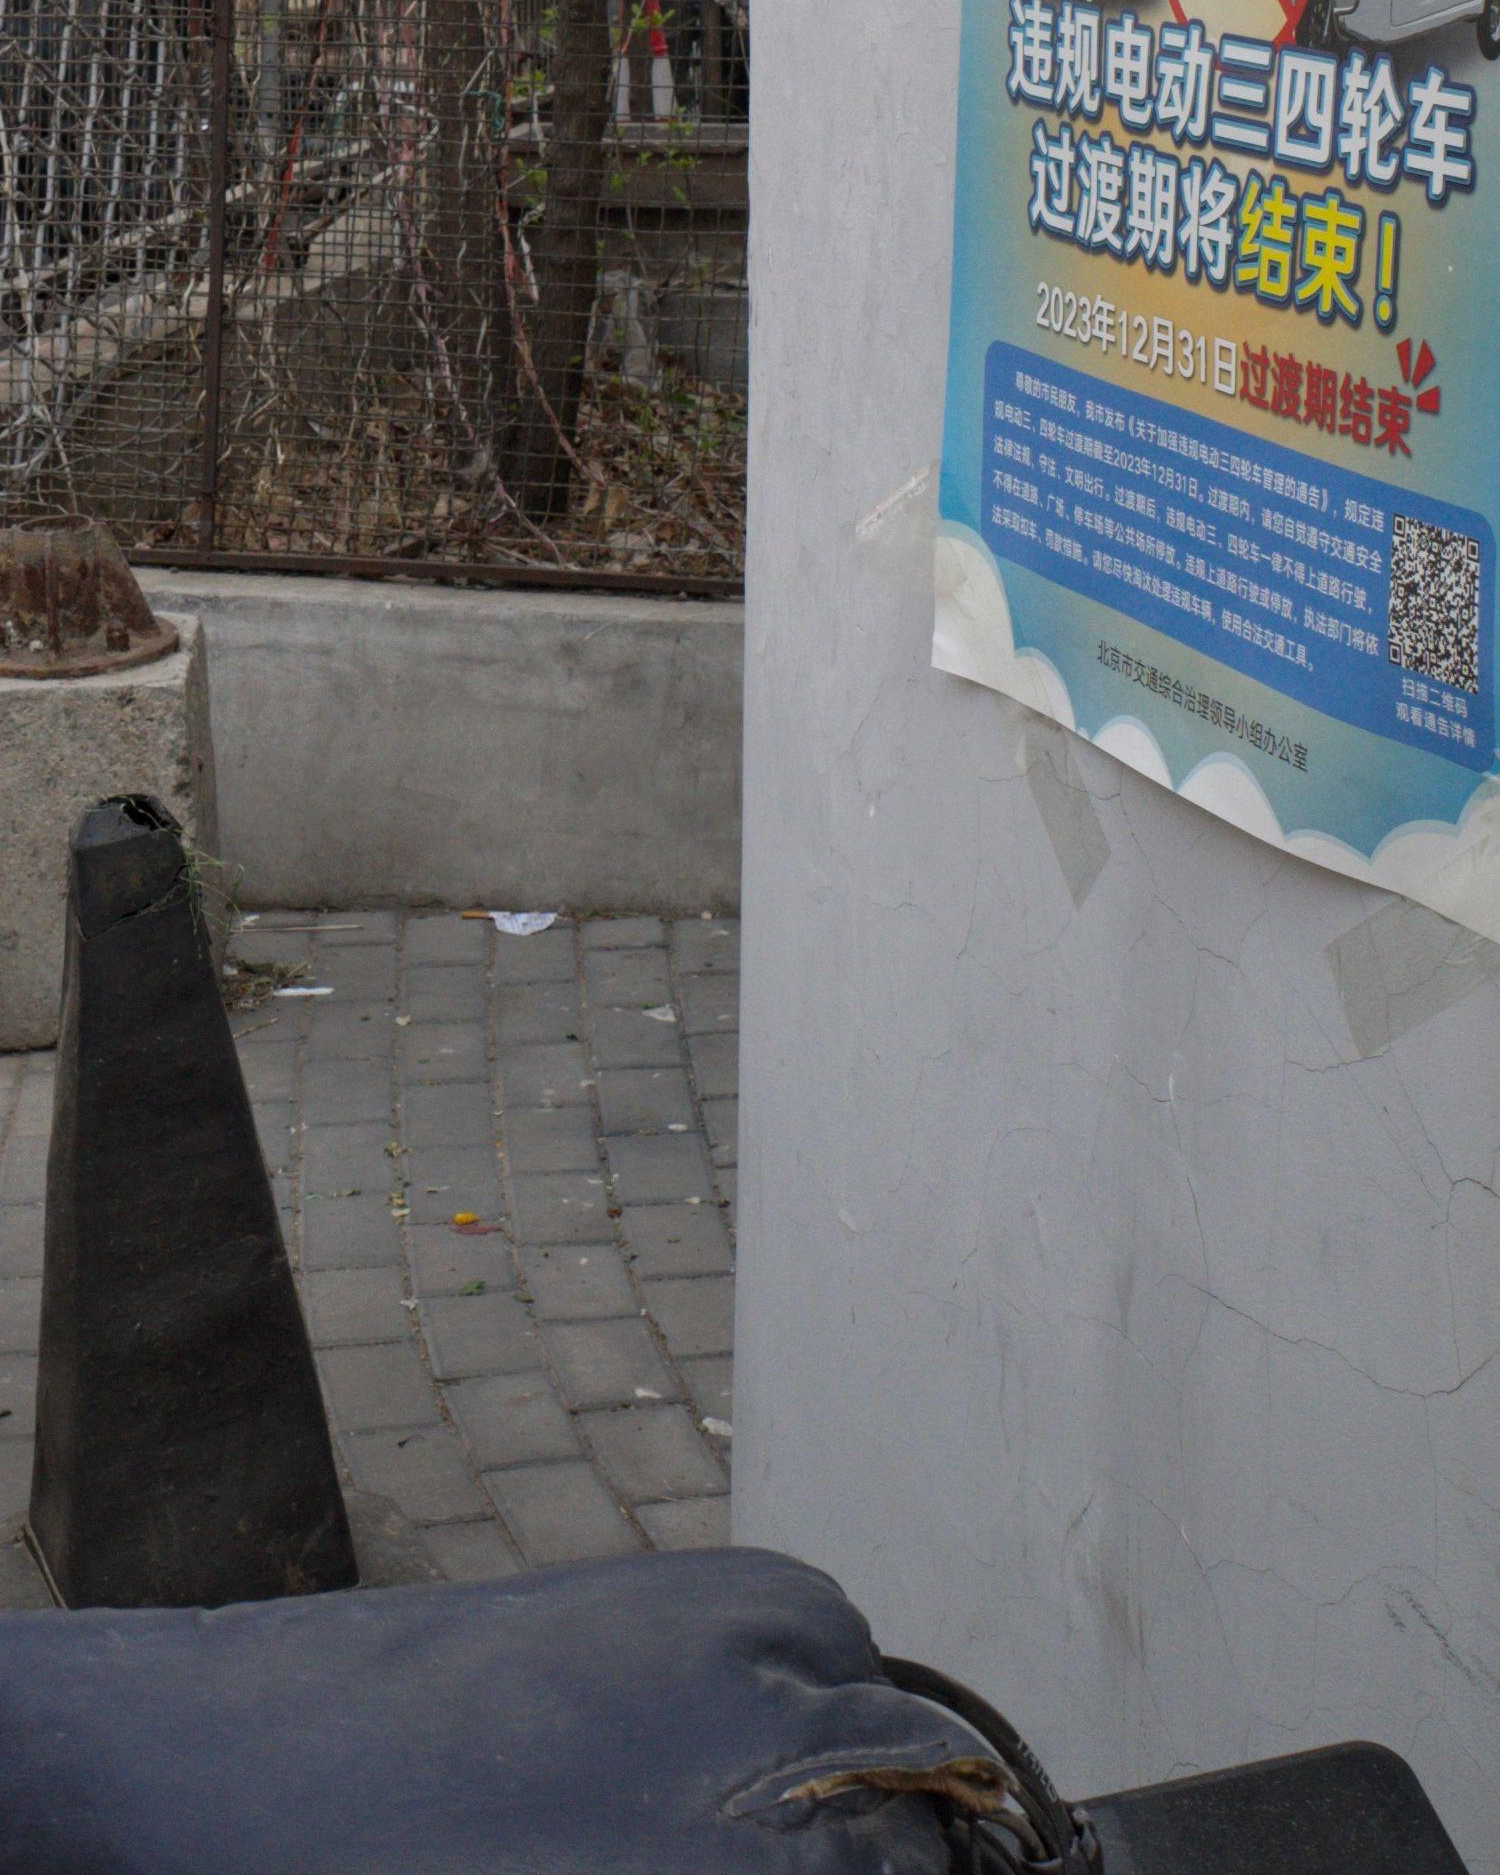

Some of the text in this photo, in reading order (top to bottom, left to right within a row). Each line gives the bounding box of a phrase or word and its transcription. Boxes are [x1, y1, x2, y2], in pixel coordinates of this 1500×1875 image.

[1030, 122, 1399, 323] 过渡期将结束！
[1035, 281, 1412, 455] 2023年12月31日过渡期结束
[1097, 638, 1309, 773] 北京市交通综合治理领导小组办公室
[1395, 702, 1477, 749] 观看通告详情
[1401, 677, 1469, 719] 扫描二维码
